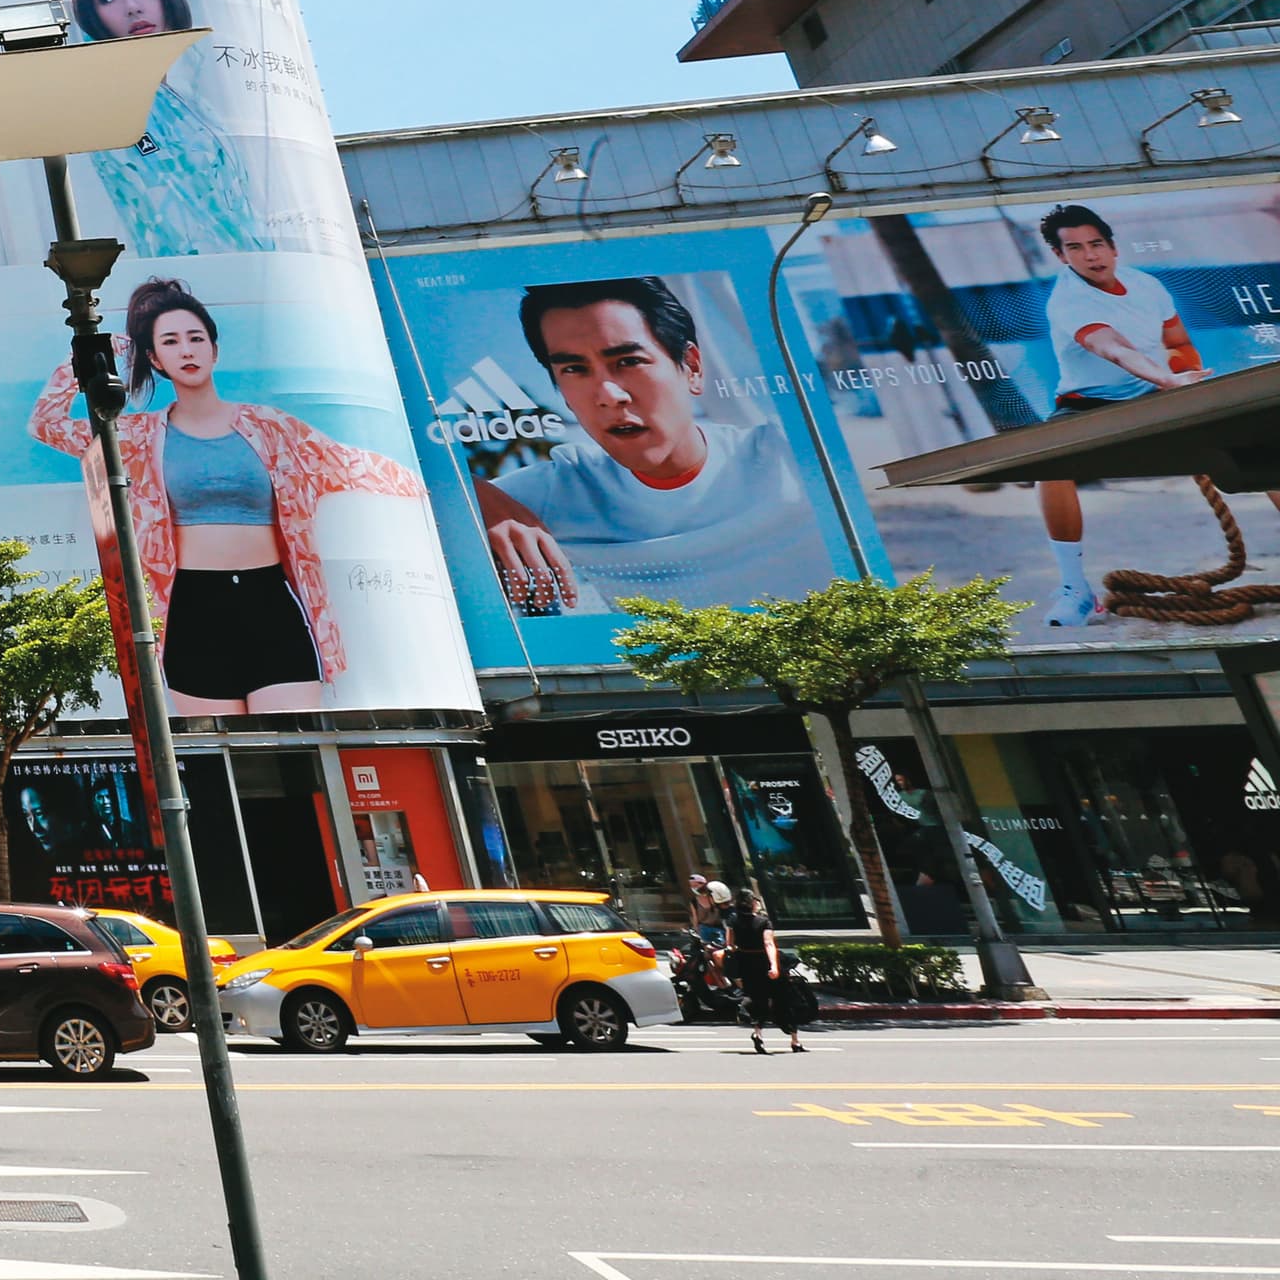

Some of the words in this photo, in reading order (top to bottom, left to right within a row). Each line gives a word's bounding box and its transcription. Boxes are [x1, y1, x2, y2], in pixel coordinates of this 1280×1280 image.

[715, 372, 817, 400] HEAT.RY
[832, 367, 899, 391] KEEPS
[907, 363, 947, 385] YOU
[953, 359, 1010, 382] COOL
[426, 409, 567, 445] adidas
[596, 727, 692, 749] SEIKO
[759, 779, 801, 789] PROSPEX
[991, 817, 1064, 831] CLIMACOOL
